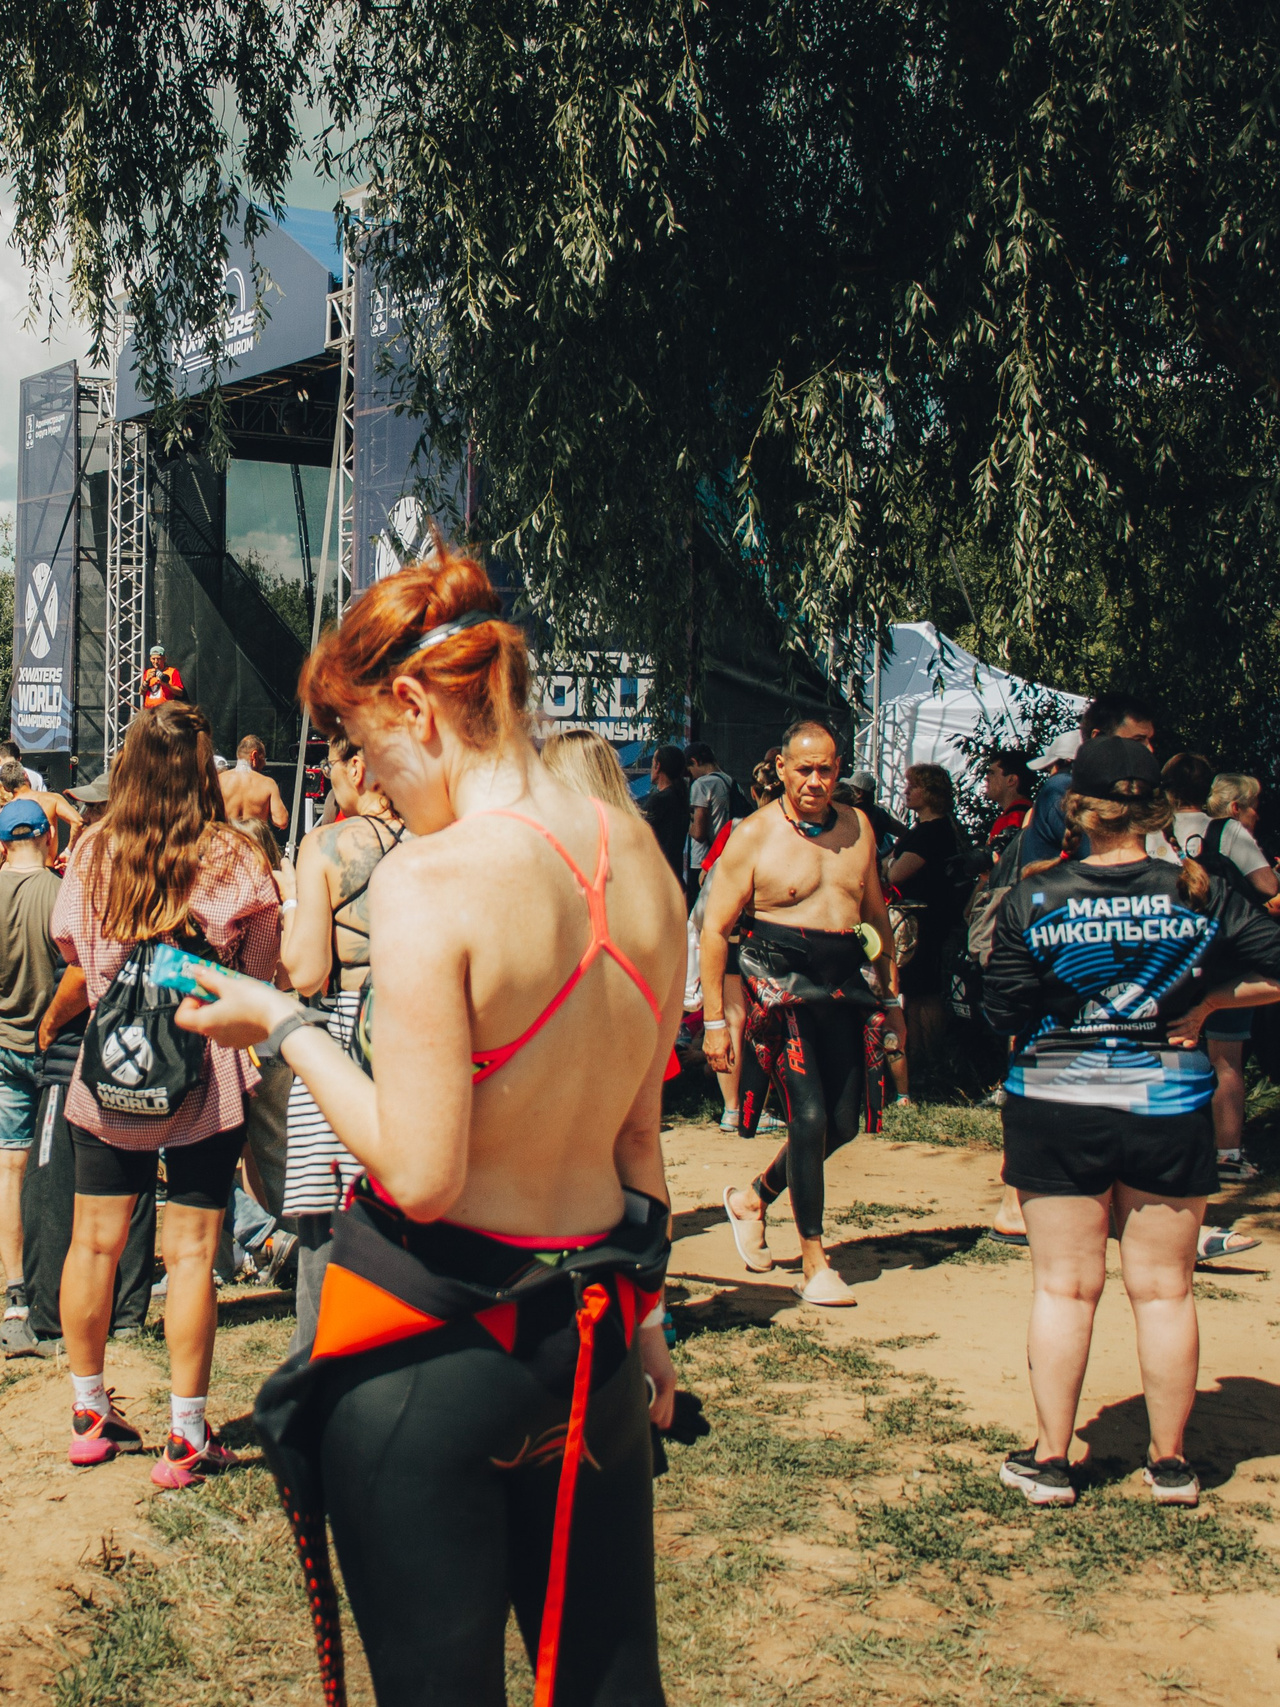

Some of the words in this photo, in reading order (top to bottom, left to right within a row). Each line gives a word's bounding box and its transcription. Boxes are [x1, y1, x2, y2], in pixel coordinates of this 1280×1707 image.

[18, 684, 63, 713] WORLD
[17, 713, 61, 729] CHAMPIONSHIP
[1067, 894, 1170, 919] МАРИЯ
[1030, 917, 1208, 948] НИКОЛЬСКАЯ
[97, 1090, 170, 1110] WORLD
